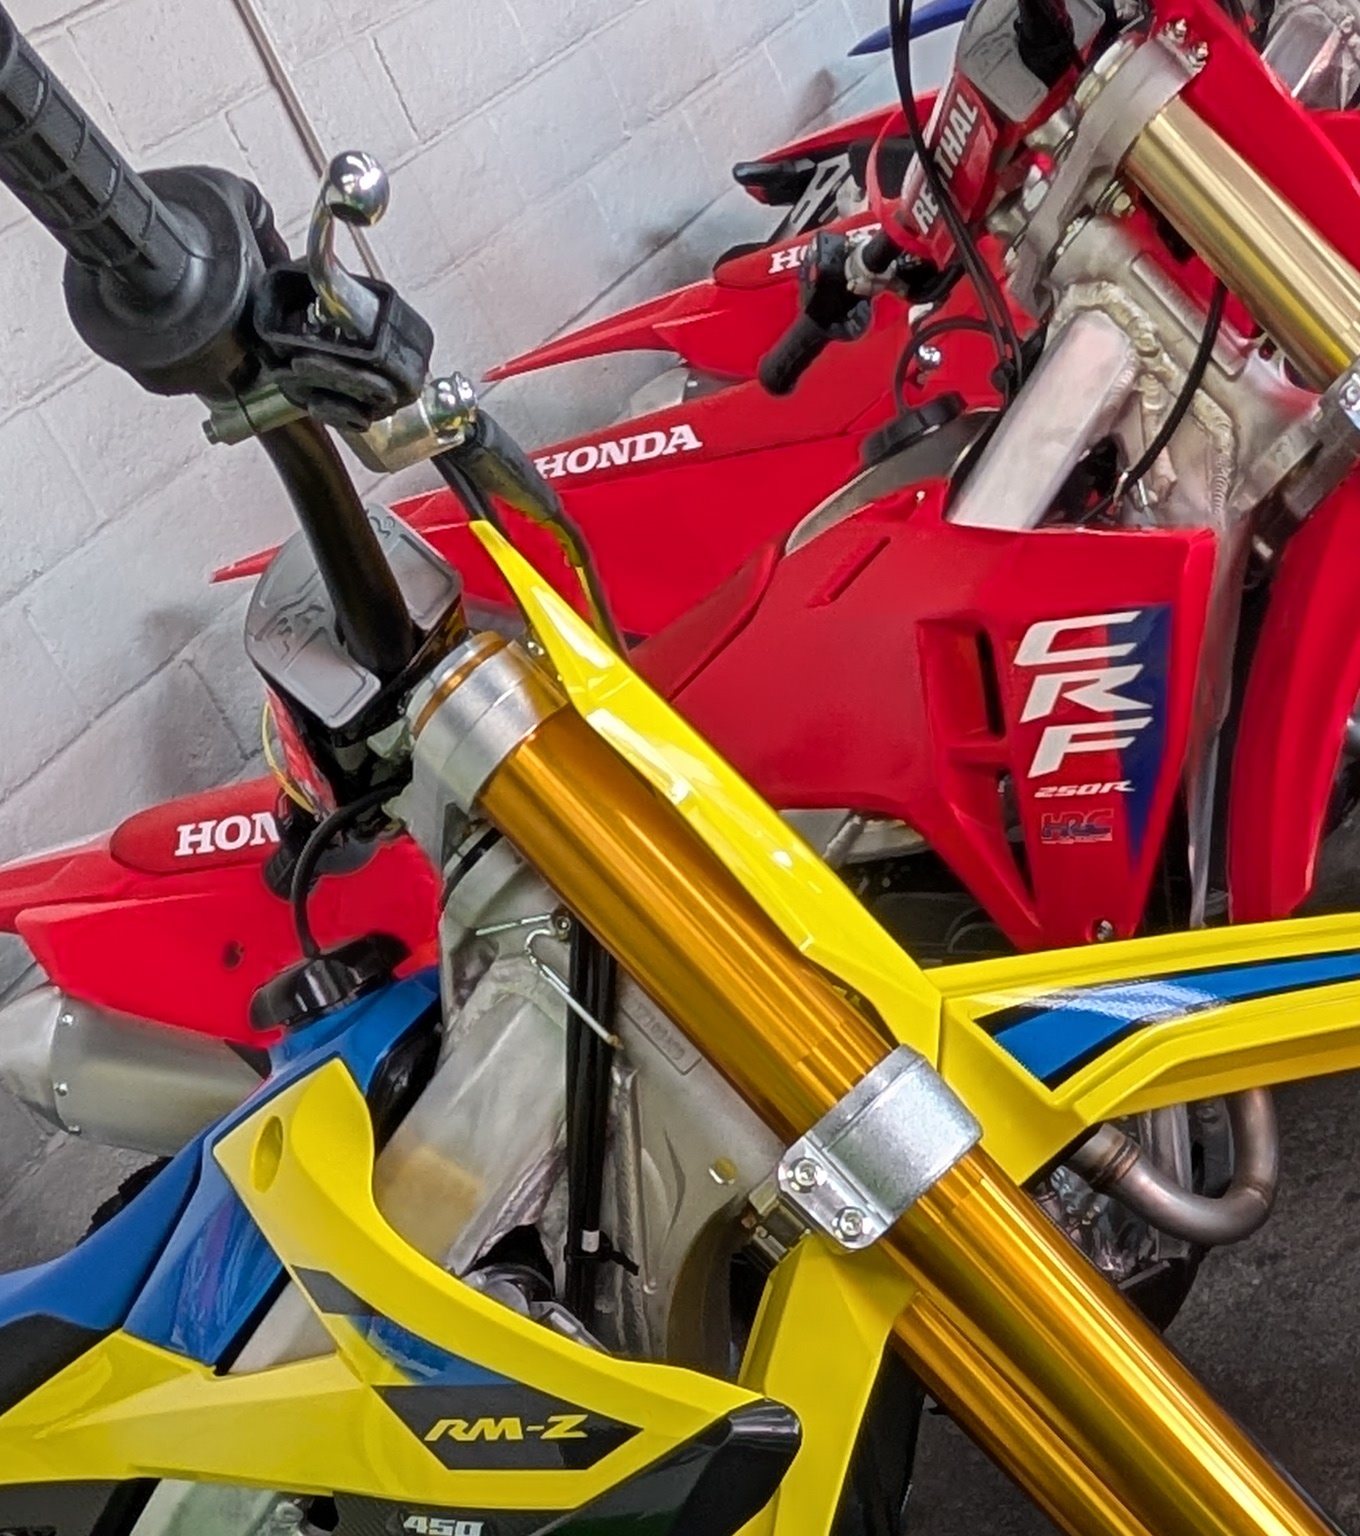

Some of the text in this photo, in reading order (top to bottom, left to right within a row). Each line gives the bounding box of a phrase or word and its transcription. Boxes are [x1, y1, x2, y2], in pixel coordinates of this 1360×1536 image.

[911, 94, 978, 235] RETHAL
[533, 424, 703, 479] HONDA
[1014, 610, 1154, 778] CRF
[1034, 780, 1136, 798] 250R
[424, 1414, 589, 1442] RM-Z
